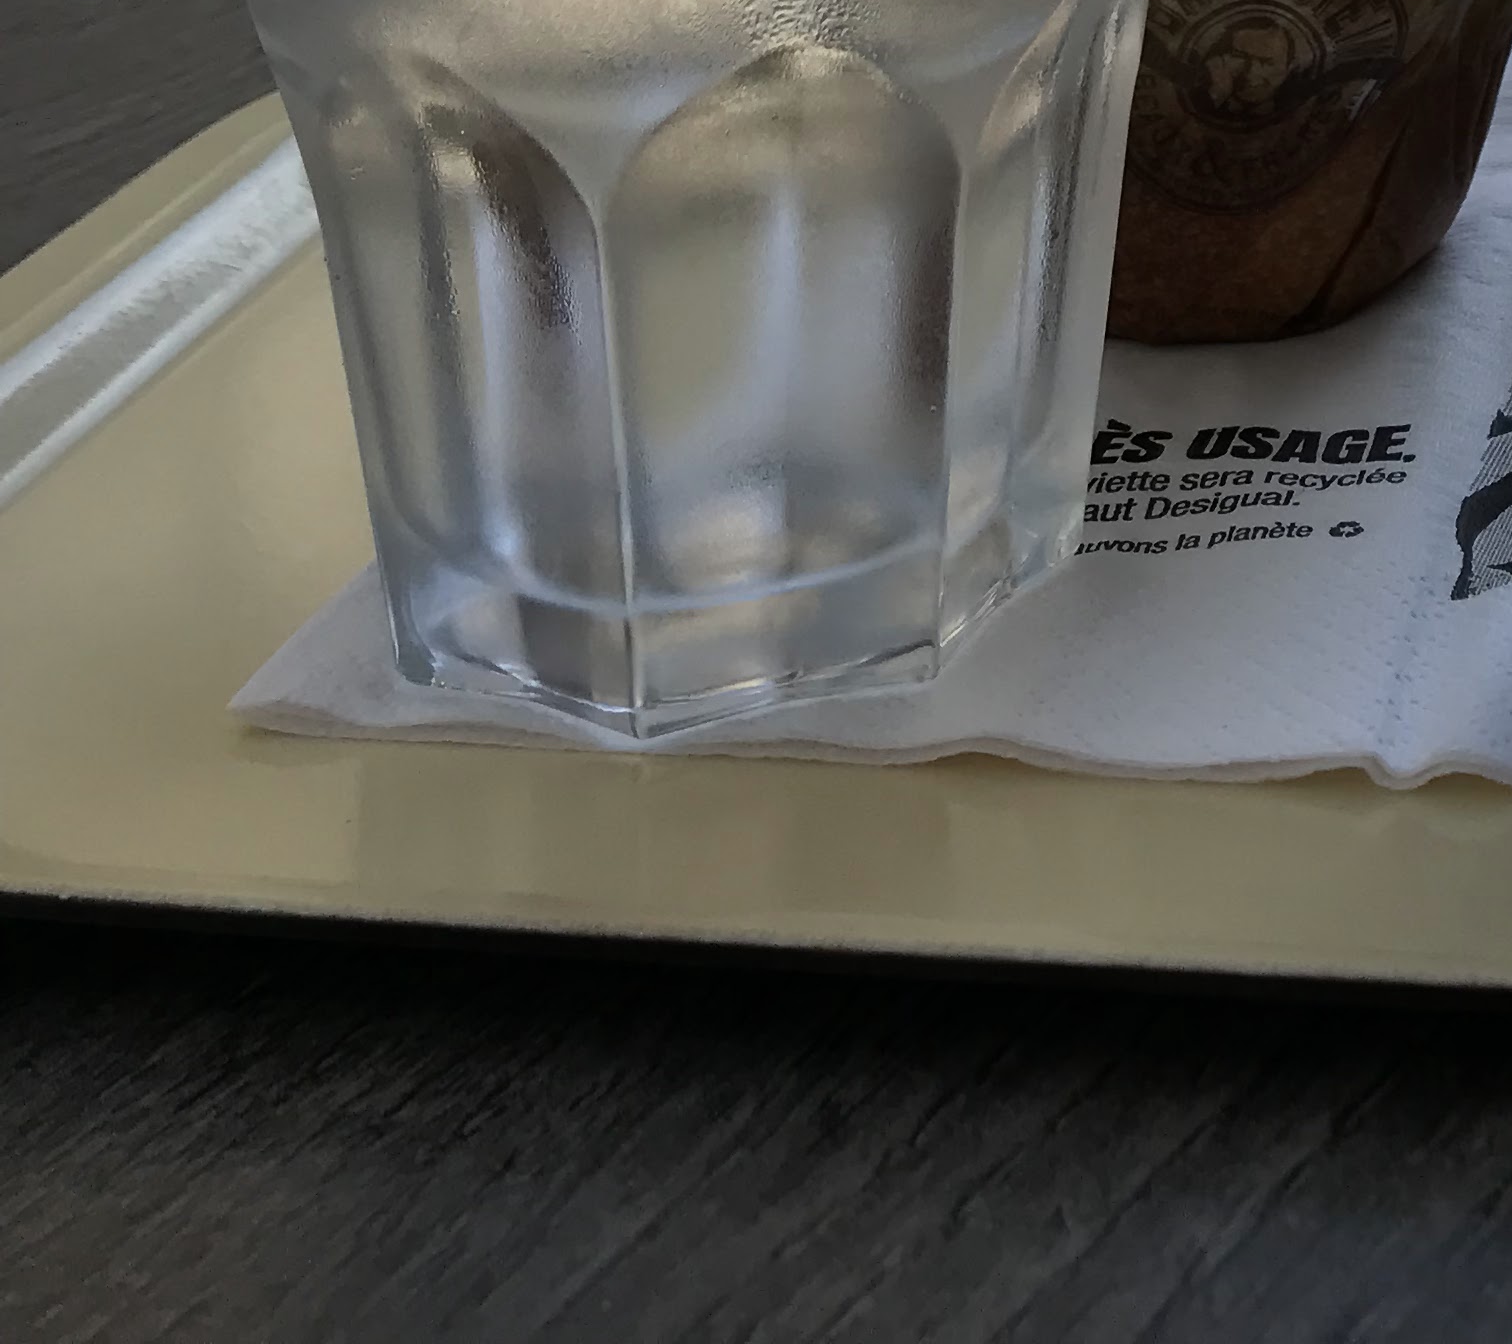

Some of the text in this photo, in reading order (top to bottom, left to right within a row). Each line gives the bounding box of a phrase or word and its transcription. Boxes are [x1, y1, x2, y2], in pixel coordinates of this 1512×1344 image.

[1185, 423, 1417, 465] USAGE.
[1178, 469, 1254, 493] sera
[1263, 467, 1408, 492] recyclée
[1143, 488, 1302, 521] Desigual.
[1174, 532, 1201, 552] la
[1206, 521, 1315, 551] planète
